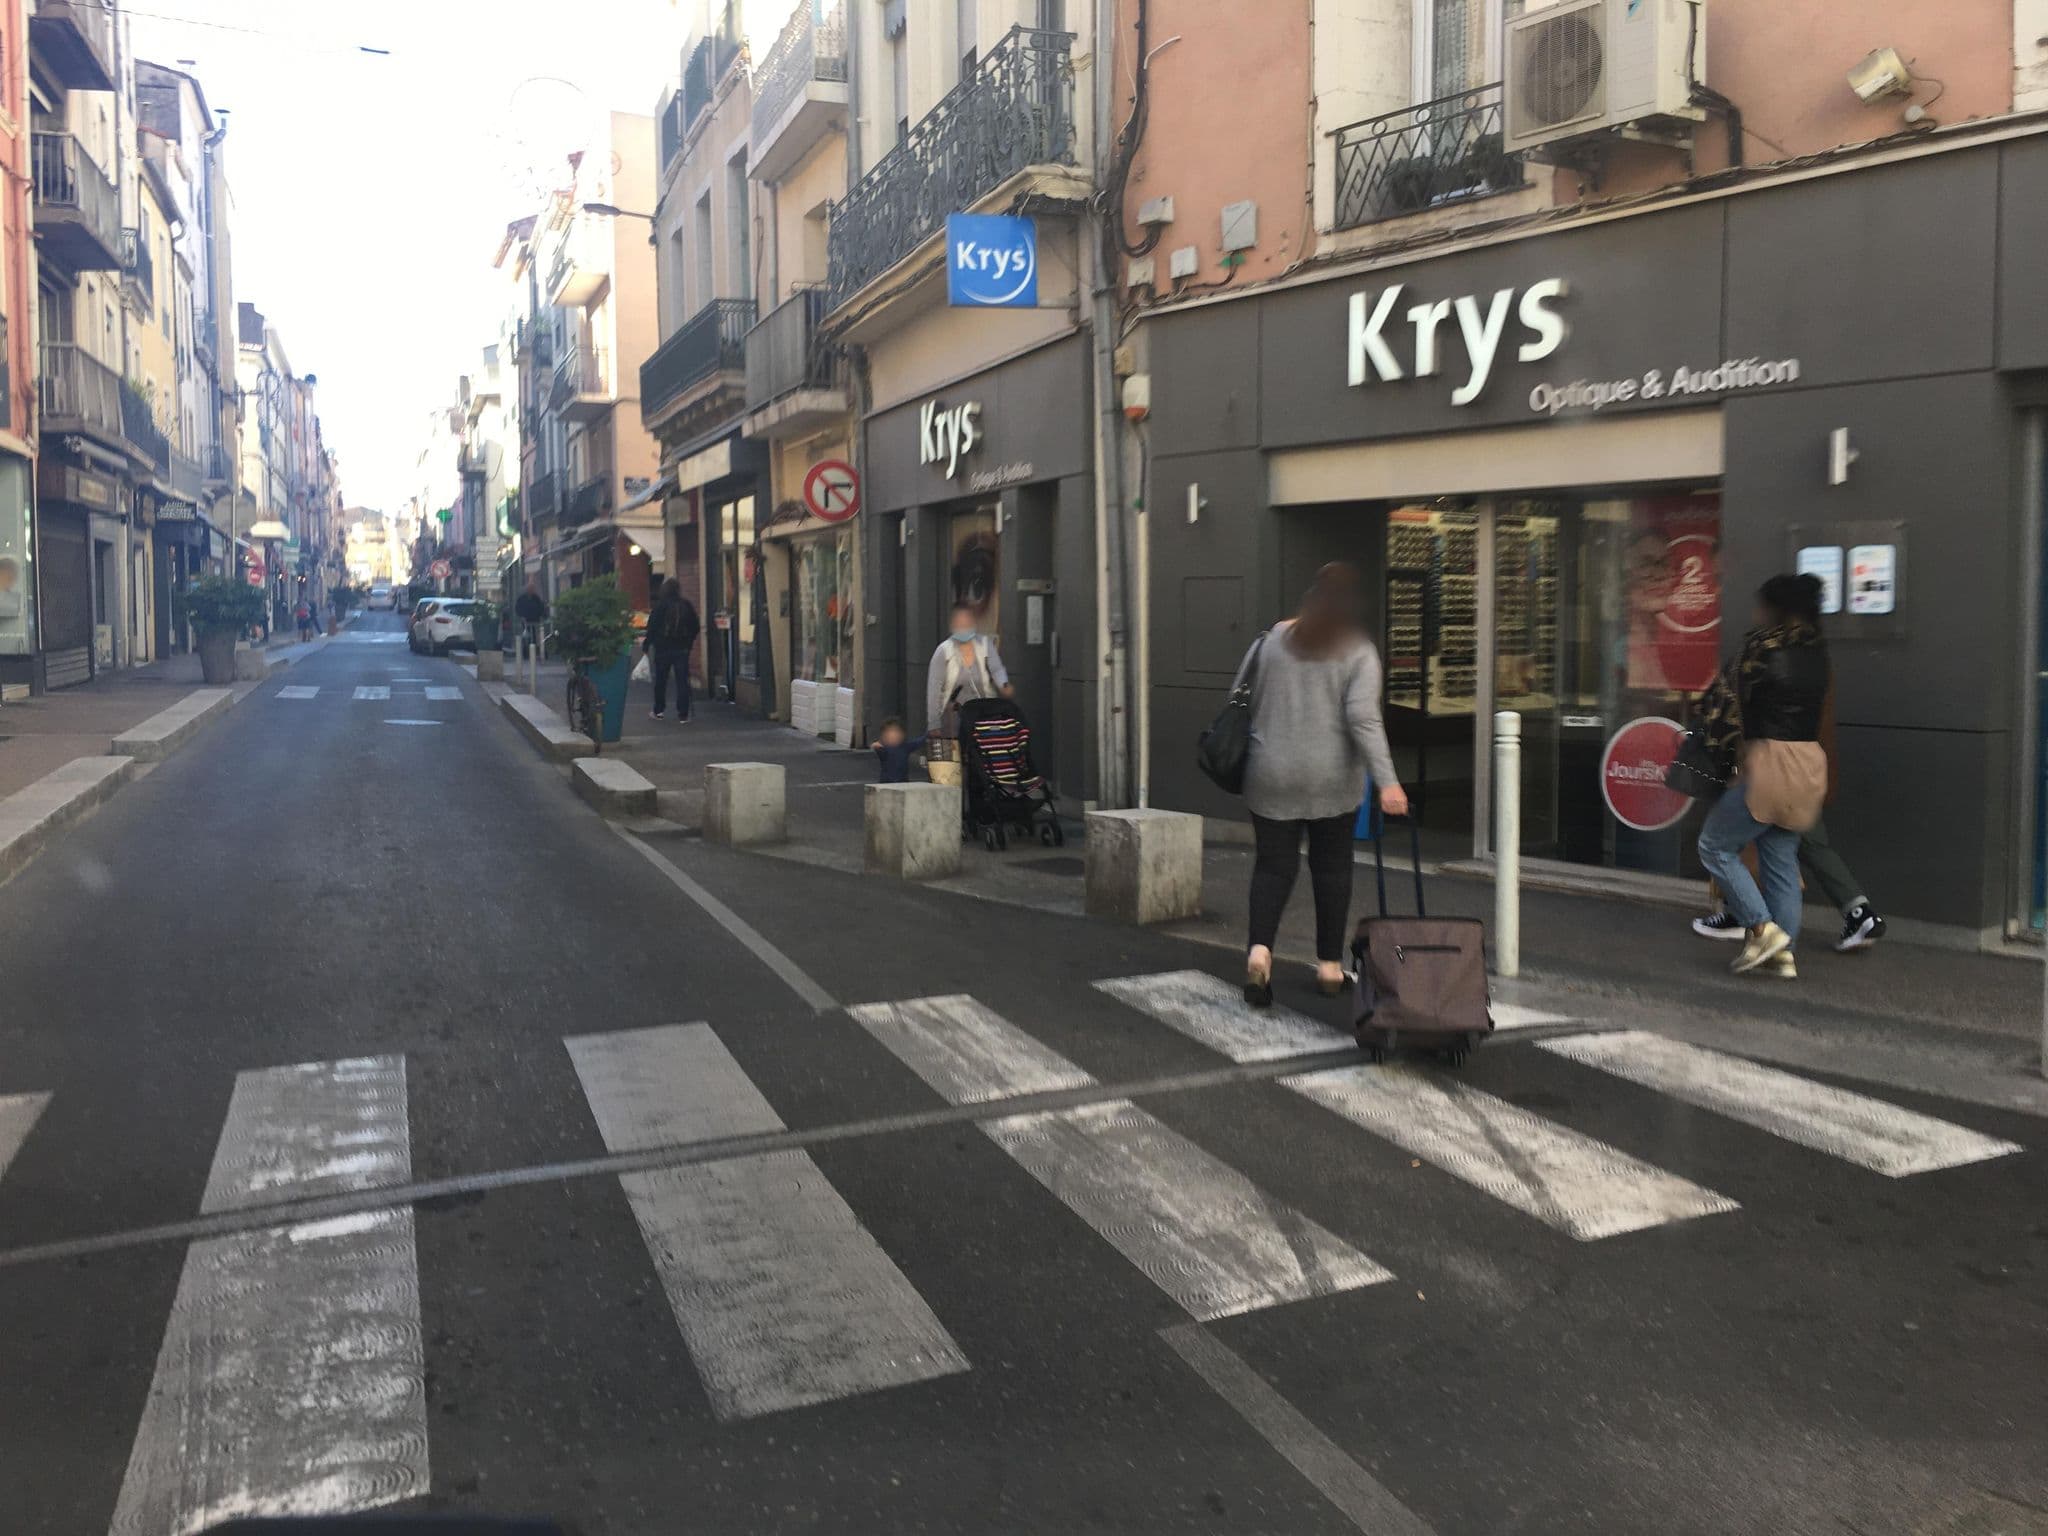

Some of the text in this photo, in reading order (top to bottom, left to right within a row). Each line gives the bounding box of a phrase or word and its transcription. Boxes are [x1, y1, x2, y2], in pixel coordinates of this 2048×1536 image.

[957, 240, 1027, 279] Krys
[1348, 277, 1567, 406] Krys
[1529, 356, 1800, 416] Optique & Audition
[920, 399, 980, 480] Krys
[1680, 555, 1704, 584] 2
